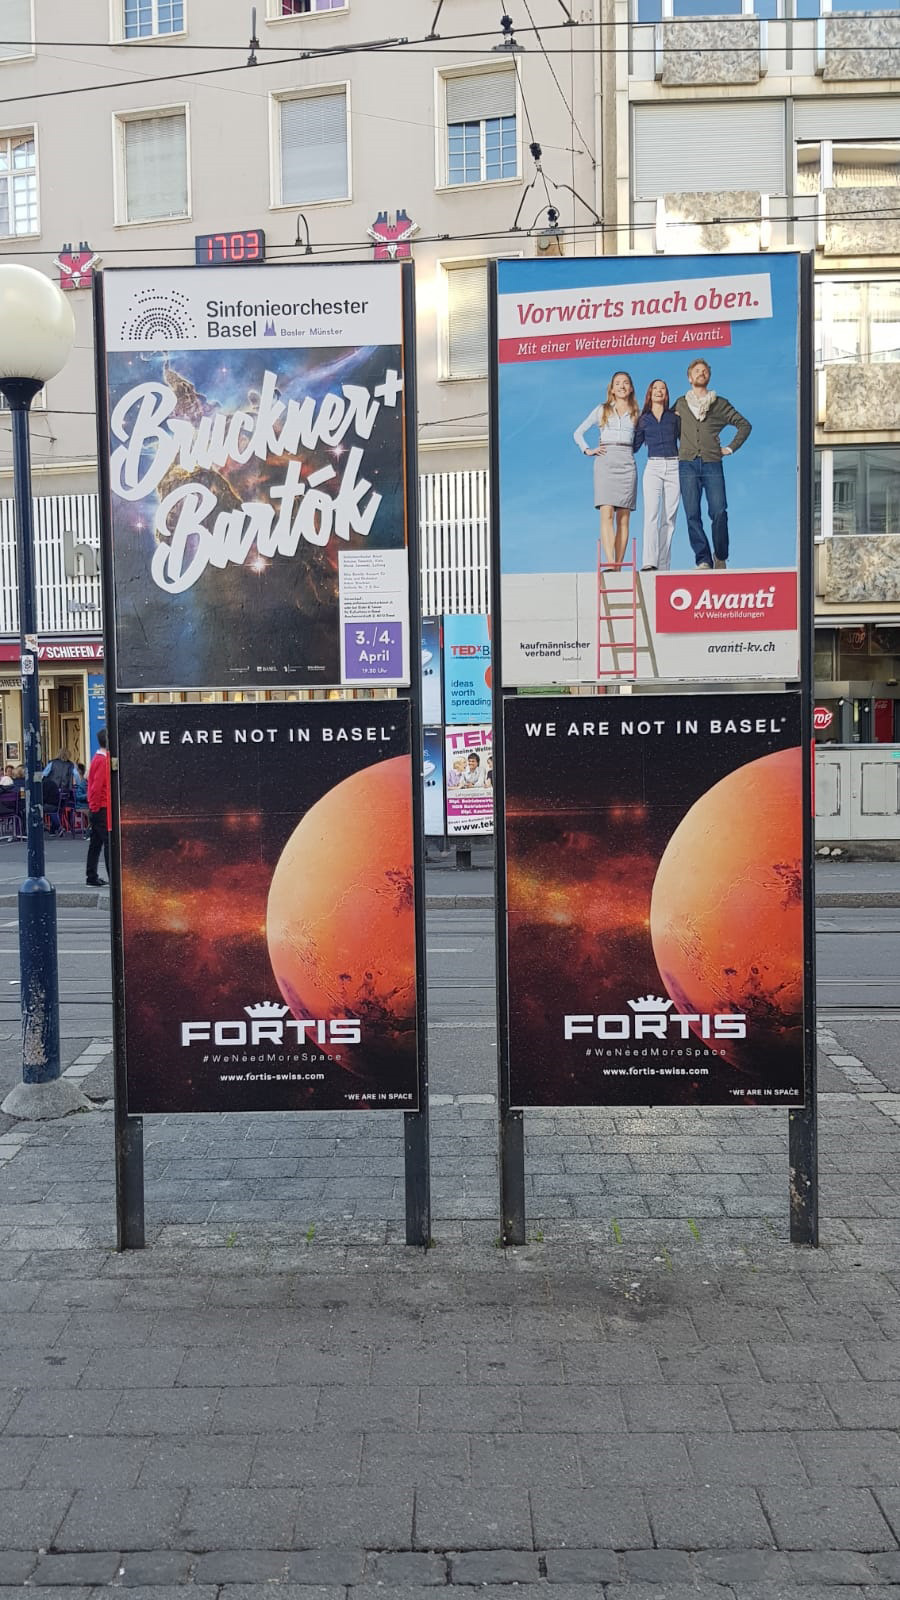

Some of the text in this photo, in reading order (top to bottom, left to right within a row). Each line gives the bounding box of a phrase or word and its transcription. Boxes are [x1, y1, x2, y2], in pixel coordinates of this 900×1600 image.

[206, 298, 368, 318] Sinfonieorchester
[517, 287, 760, 325] Vorwärts nach oben.
[207, 320, 257, 338] Basel
[280, 326, 343, 336] Basler Münster
[517, 327, 724, 356] Mit einer Weiterbildung bei Avanti.
[151, 446, 383, 594] Bartók
[695, 586, 776, 610] Avanti
[705, 610, 765, 620] Weiterbildungen
[520, 641, 591, 650] kaufmännischer
[708, 641, 775, 654] avanti-kv.ch
[46, 646, 94, 658] SCHIEFEN
[359, 650, 390, 664] April
[525, 649, 561, 657] verband
[451, 680, 474, 688] ideas
[451, 689, 475, 697] worth
[451, 698, 491, 707] spreading
[814, 712, 833, 724] TOP
[525, 722, 556, 737] WE
[567, 721, 609, 736] ARE
[621, 720, 665, 735] NOT
[676, 720, 698, 735] IN
[139, 730, 170, 744] WE
[181, 730, 223, 744] ARE
[234, 729, 278, 743] NOT
[289, 728, 310, 742] IN
[564, 1013, 747, 1040] FORTIS
[181, 1019, 361, 1047] FORTIS
[203, 1052, 342, 1064] #WeNeedMoreSpace
[585, 1047, 727, 1058] #WeNeedMoreSpace
[220, 1072, 325, 1082] www.fortis-swiss.com
[603, 1066, 709, 1076] www.fortis-swiss.com
[773, 1088, 799, 1096] SPACE
